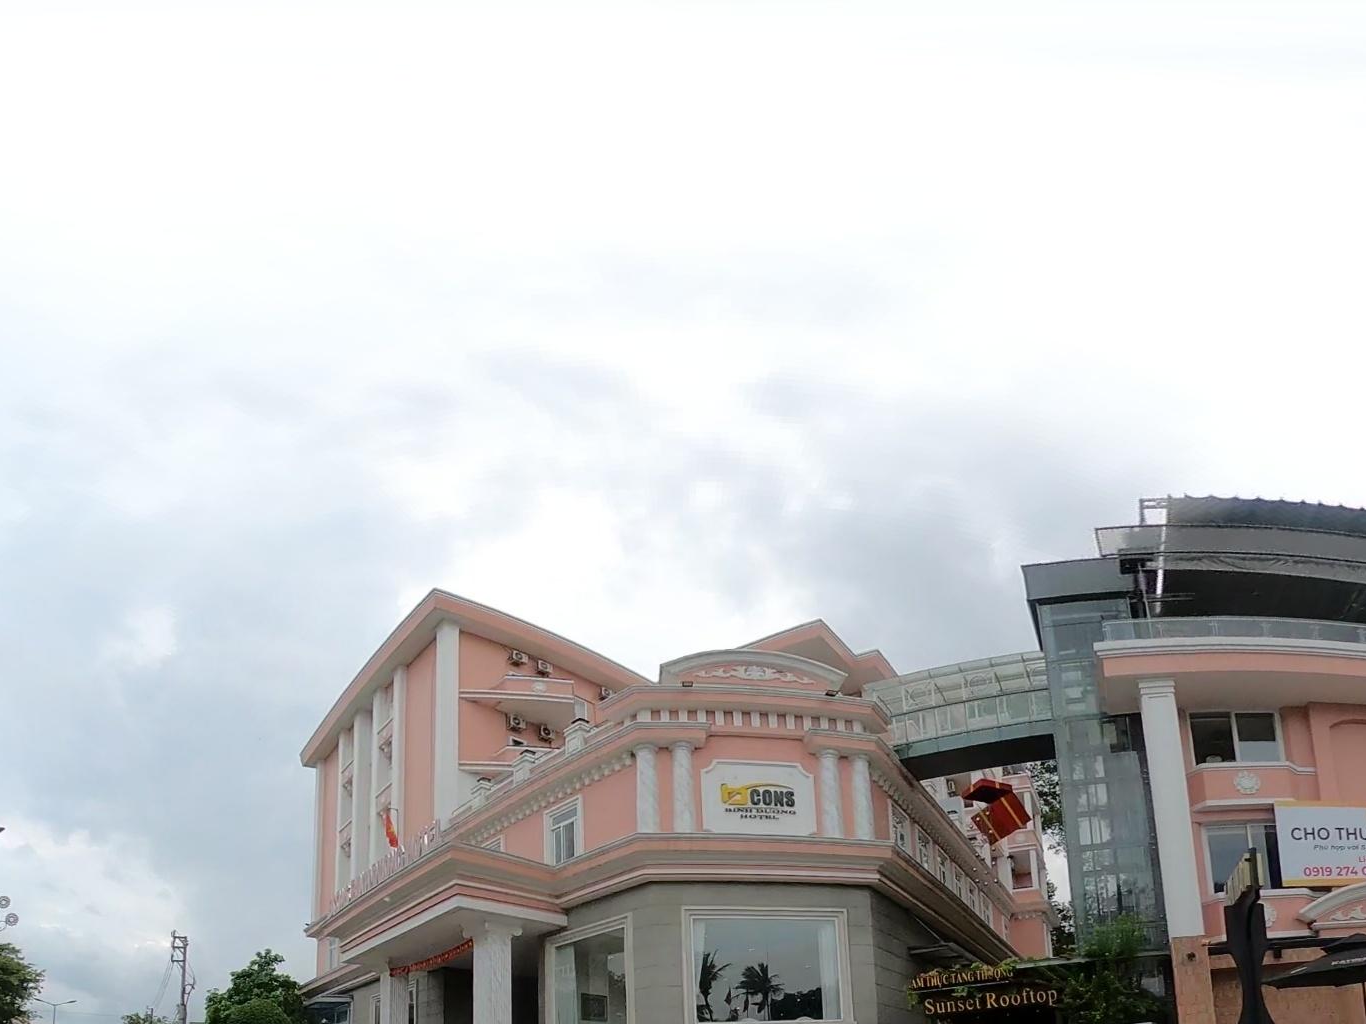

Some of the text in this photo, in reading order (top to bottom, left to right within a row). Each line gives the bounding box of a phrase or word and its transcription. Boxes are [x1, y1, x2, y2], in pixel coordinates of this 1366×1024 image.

[750, 789, 795, 807] CONS
[1290, 827, 1330, 841] CHO
[1303, 866, 1333, 877] 0919
[1335, 866, 1358, 877] 274
[924, 987, 1058, 1015] Sunset Rooftop
